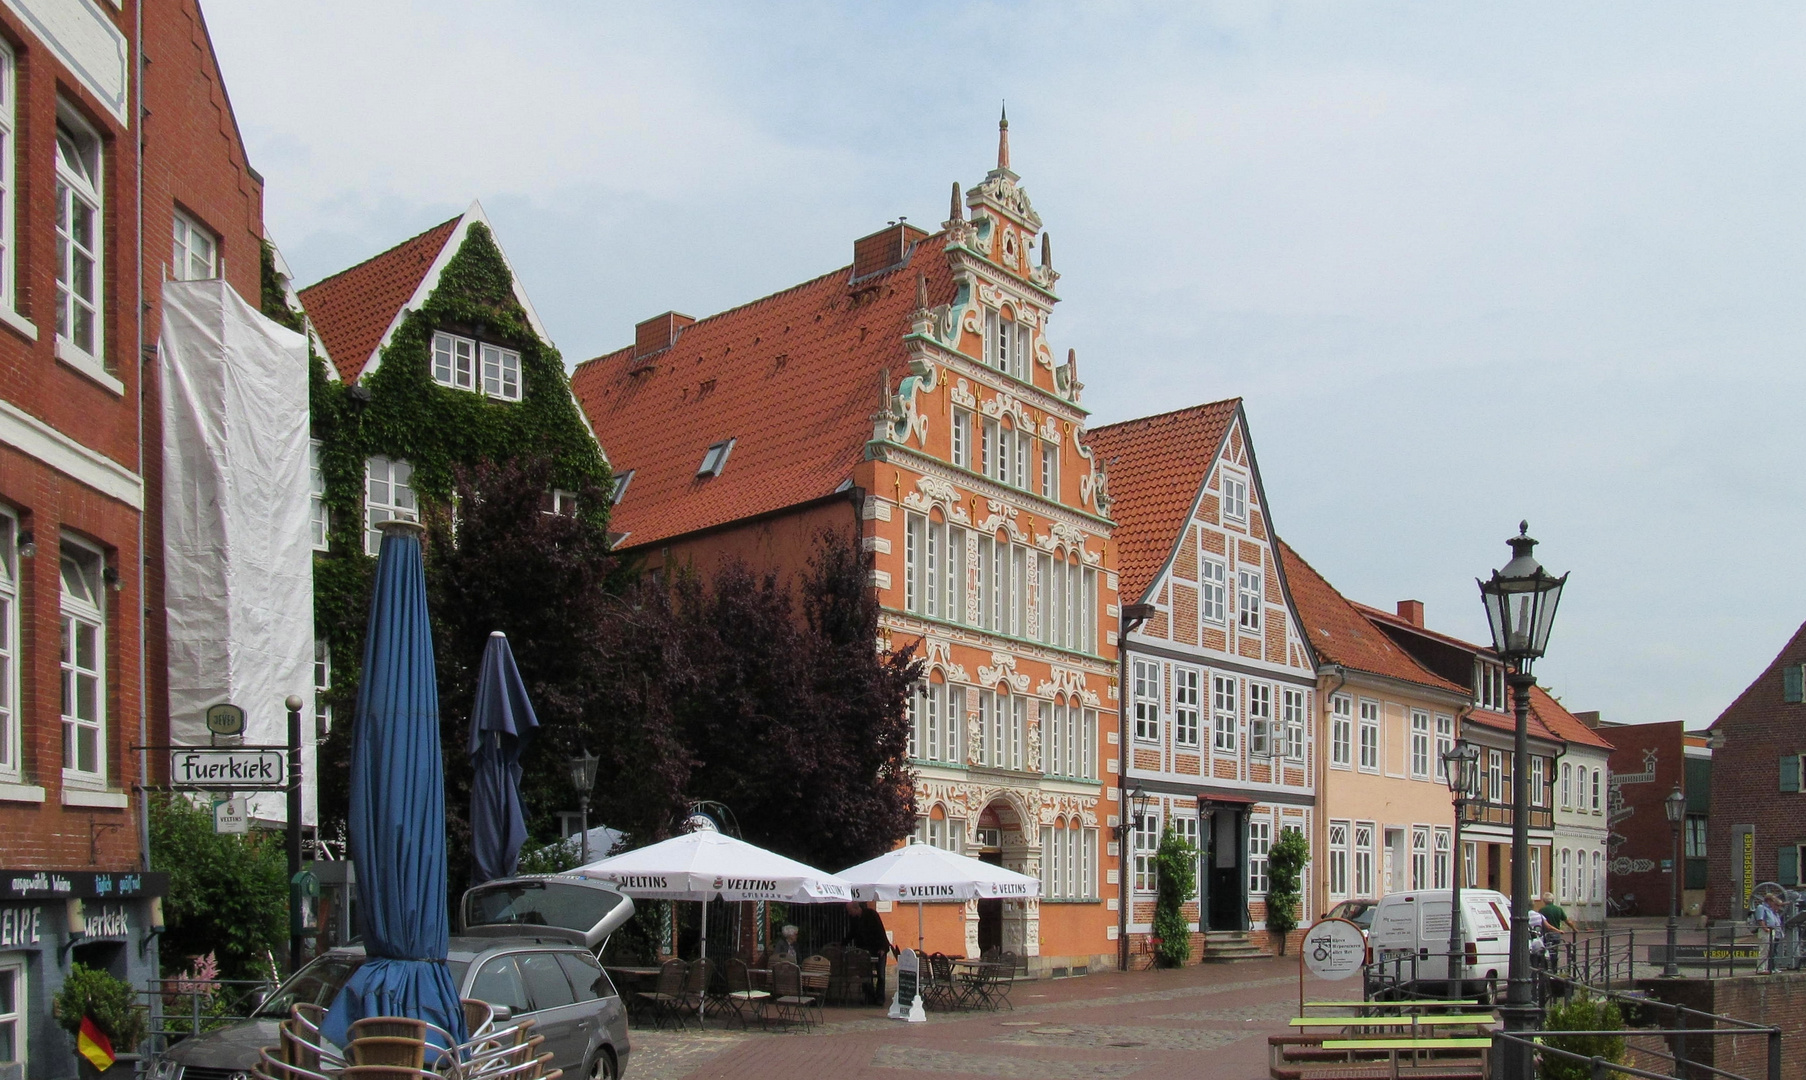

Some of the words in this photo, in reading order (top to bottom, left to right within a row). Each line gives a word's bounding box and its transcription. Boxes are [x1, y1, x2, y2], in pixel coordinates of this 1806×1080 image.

[213, 715, 236, 726] JEVER
[182, 755, 273, 781] Fuerkiek
[621, 876, 667, 888] VELTINS
[727, 879, 777, 891] VELTINS
[822, 883, 845, 896] VELTINS
[910, 885, 954, 897] VELTINS
[999, 883, 1026, 894] VELTINS
[83, 905, 129, 937] uerkiek
